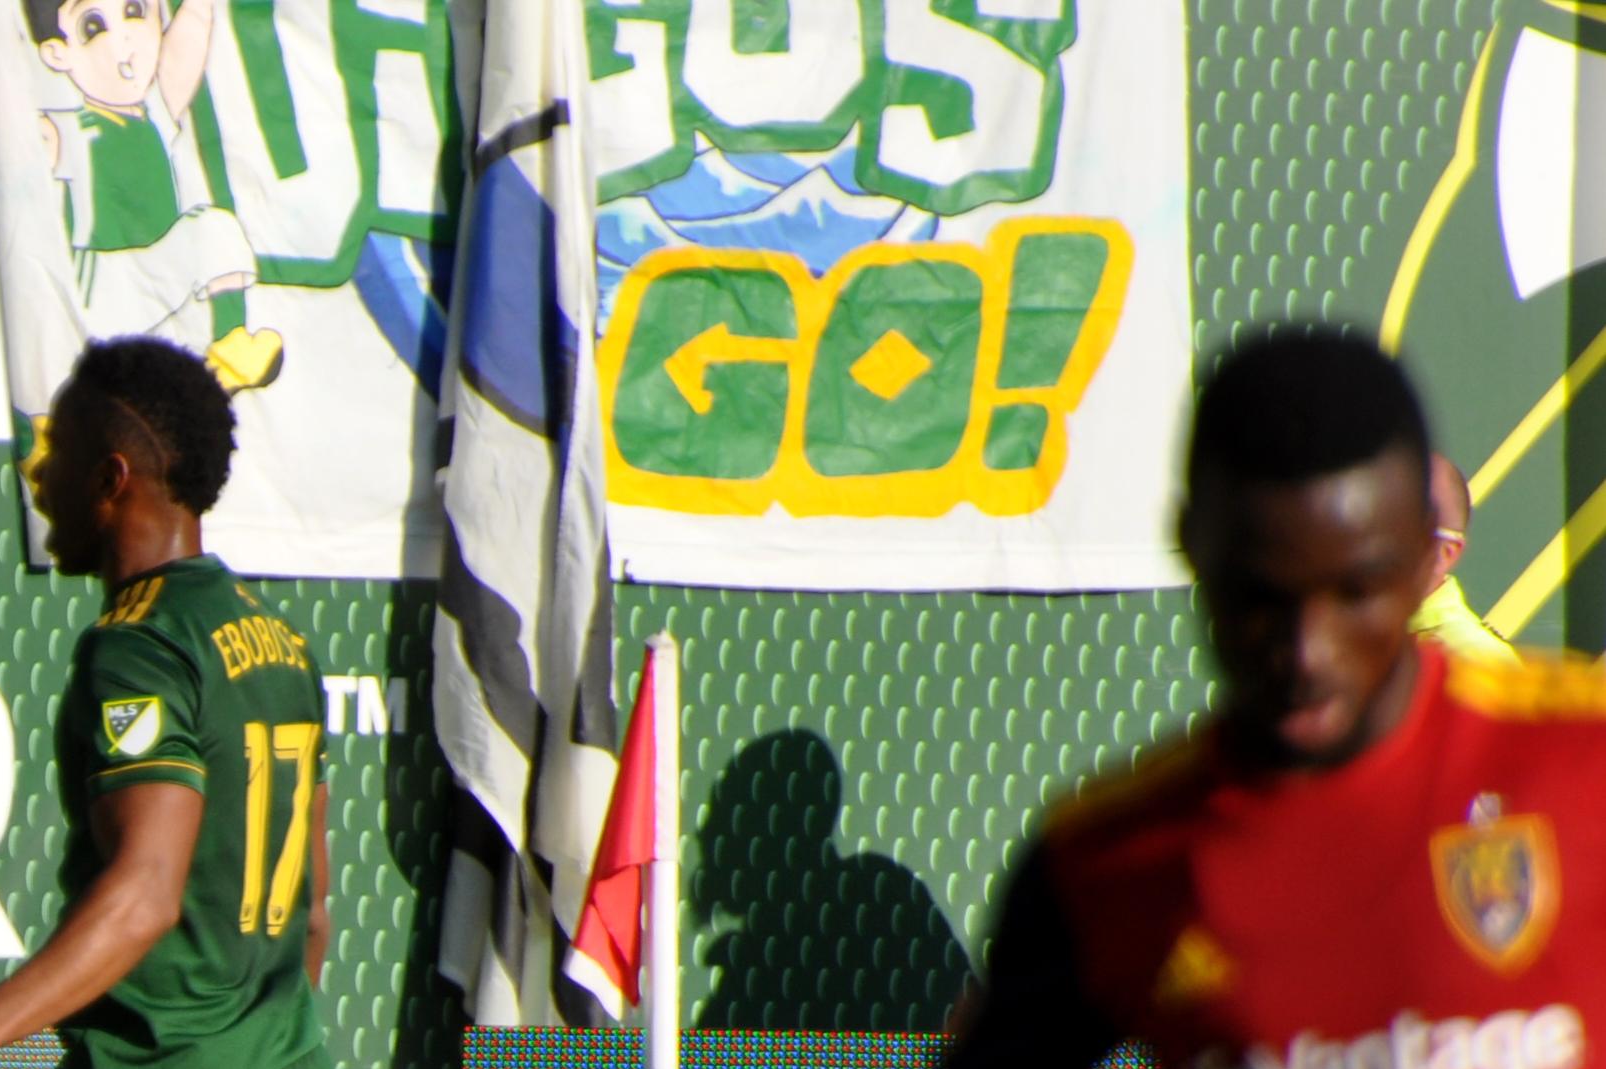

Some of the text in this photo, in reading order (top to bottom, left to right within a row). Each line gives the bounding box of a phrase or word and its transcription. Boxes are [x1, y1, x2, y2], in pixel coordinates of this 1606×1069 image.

[594, 214, 1136, 518] GO!
[107, 704, 138, 718] MLS
[239, 720, 321, 936] 17
